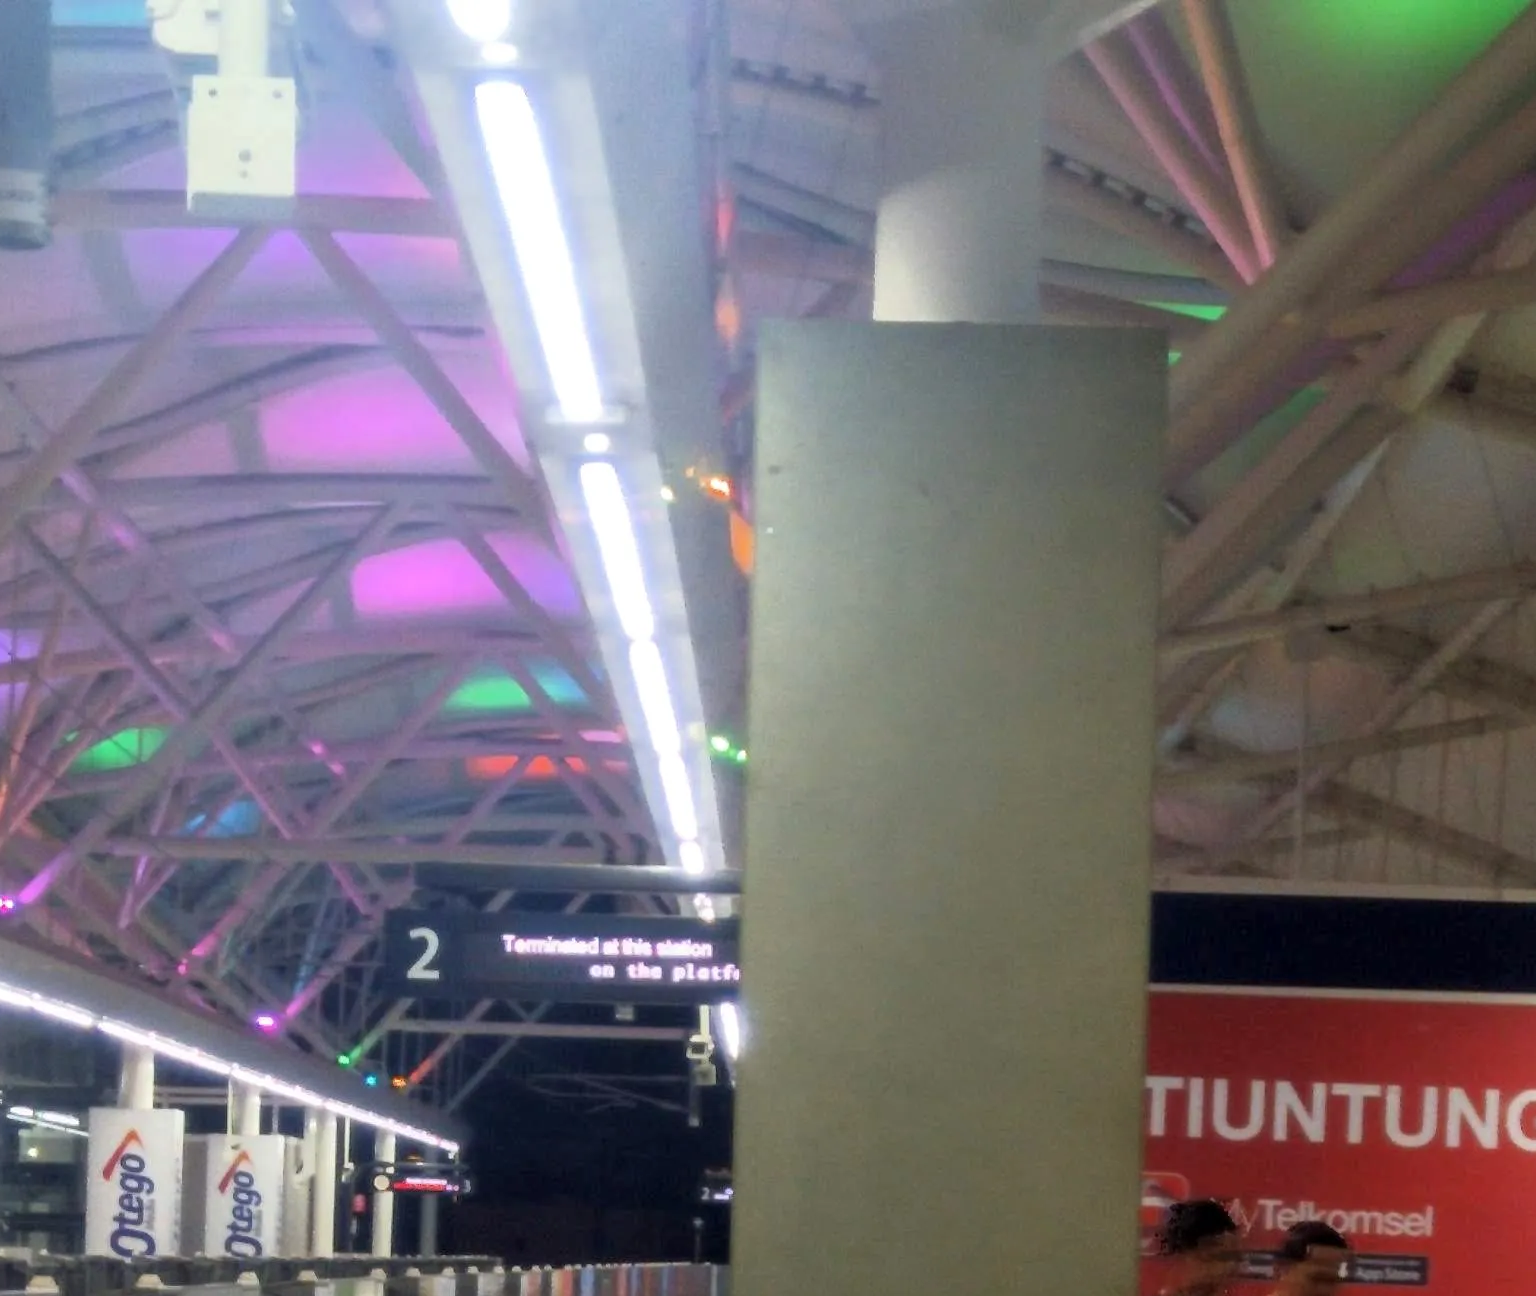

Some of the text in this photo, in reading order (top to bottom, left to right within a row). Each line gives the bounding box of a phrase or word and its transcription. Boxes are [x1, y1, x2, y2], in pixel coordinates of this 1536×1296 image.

[406, 926, 441, 980] 2
[501, 933, 714, 959] Terminated at this station
[588, 962, 740, 983] on the platf
[110, 1153, 157, 1258] Otego
[225, 1170, 263, 1258] Otego
